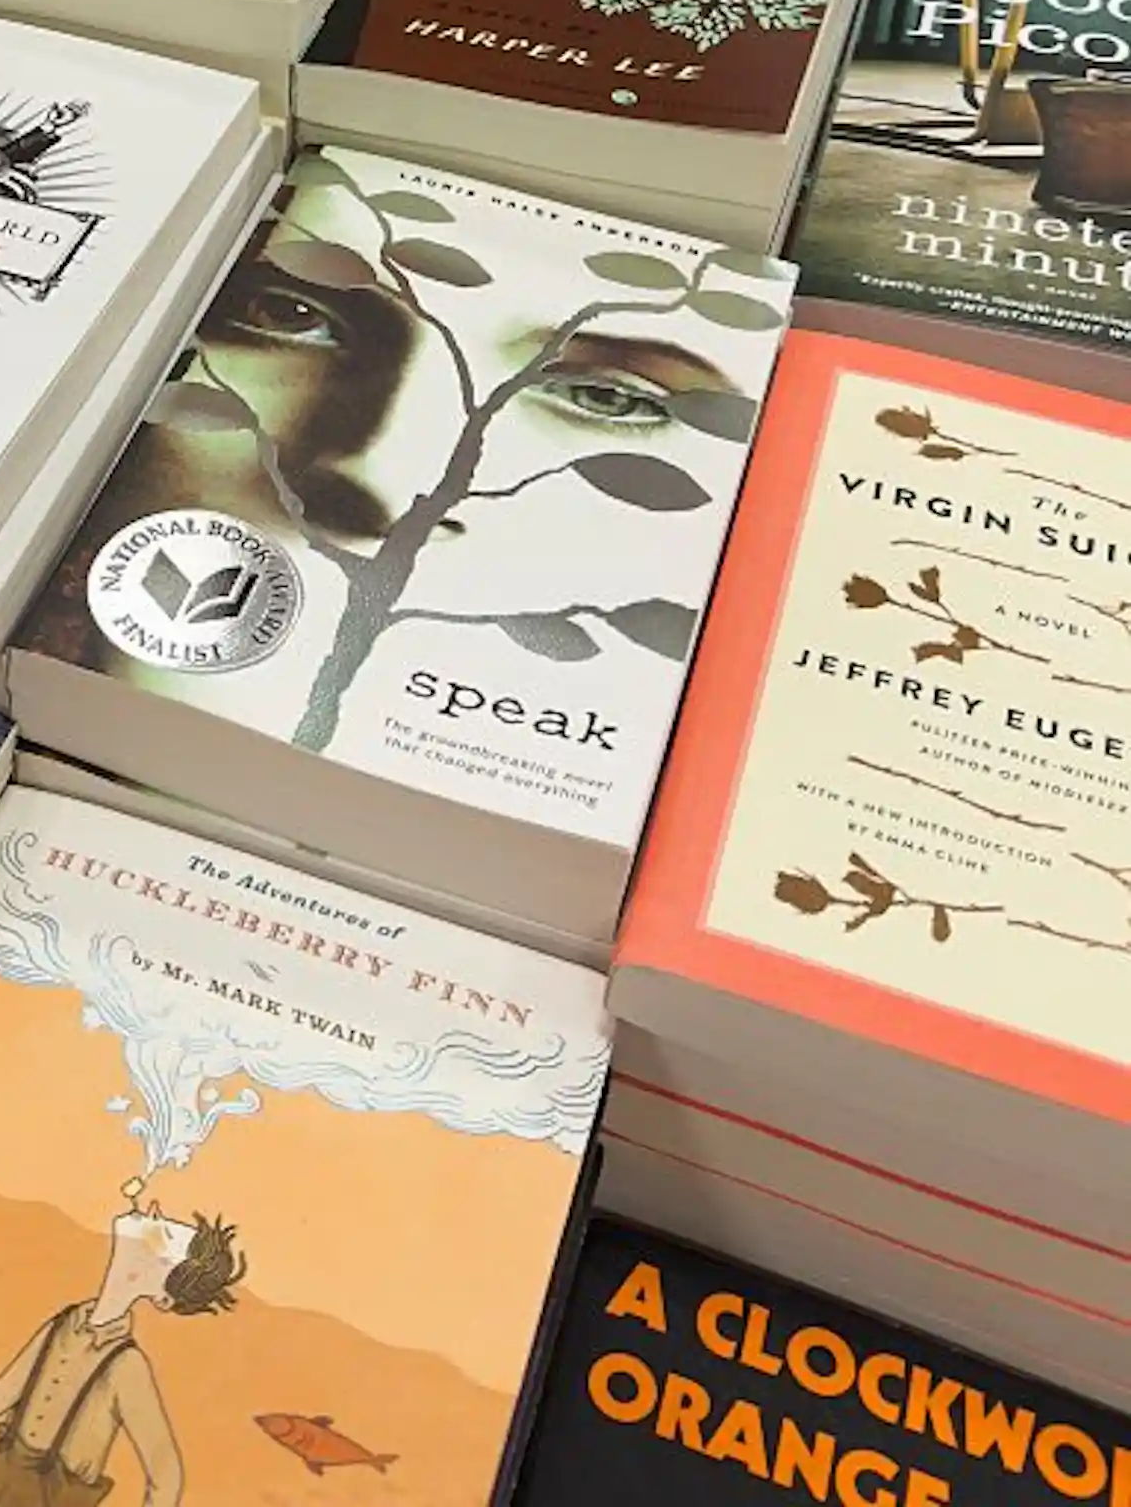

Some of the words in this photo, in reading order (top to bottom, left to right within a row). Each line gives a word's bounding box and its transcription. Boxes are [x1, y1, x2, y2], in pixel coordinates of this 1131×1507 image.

[403, 18, 595, 68] HARPER
[613, 57, 707, 82] LEE
[399, 172, 476, 198] LAURIE
[573, 217, 699, 258] ANDERSON
[891, 193, 1131, 255] ninete
[896, 229, 1131, 292] minut
[839, 472, 1011, 535] VIRGIN
[1031, 495, 1088, 521] The
[99, 517, 201, 593] NATIONAL
[205, 519, 271, 565] BOOK
[112, 612, 224, 662] FINALIST
[1018, 610, 1092, 639] NOVEL
[405, 669, 619, 752] speak
[794, 647, 983, 718] JEFFREY
[418, 729, 559, 781] groundbreaking
[910, 718, 991, 752] PULITZER
[919, 745, 992, 776] AUTHOR
[999, 769, 1020, 783] OF
[424, 748, 500, 781] changed
[503, 771, 601, 810] everything
[796, 780, 839, 802] WITH
[862, 802, 902, 824] NEW
[909, 817, 1053, 868] INTRODUCTION
[874, 832, 928, 855] EMMA
[934, 848, 990, 874] CLINE
[188, 854, 231, 881] The
[235, 871, 372, 932] Adventures
[378, 923, 408, 942] of
[44, 846, 395, 978] HUCKLEBERRY
[406, 968, 536, 1030] FINN
[131, 950, 155, 974] by
[161, 961, 200, 987] Mr.
[206, 976, 284, 1017] MARK
[291, 1005, 379, 1052] TWAIN
[605, 1260, 667, 1334] A
[587, 1351, 951, 1507] ORANGE
